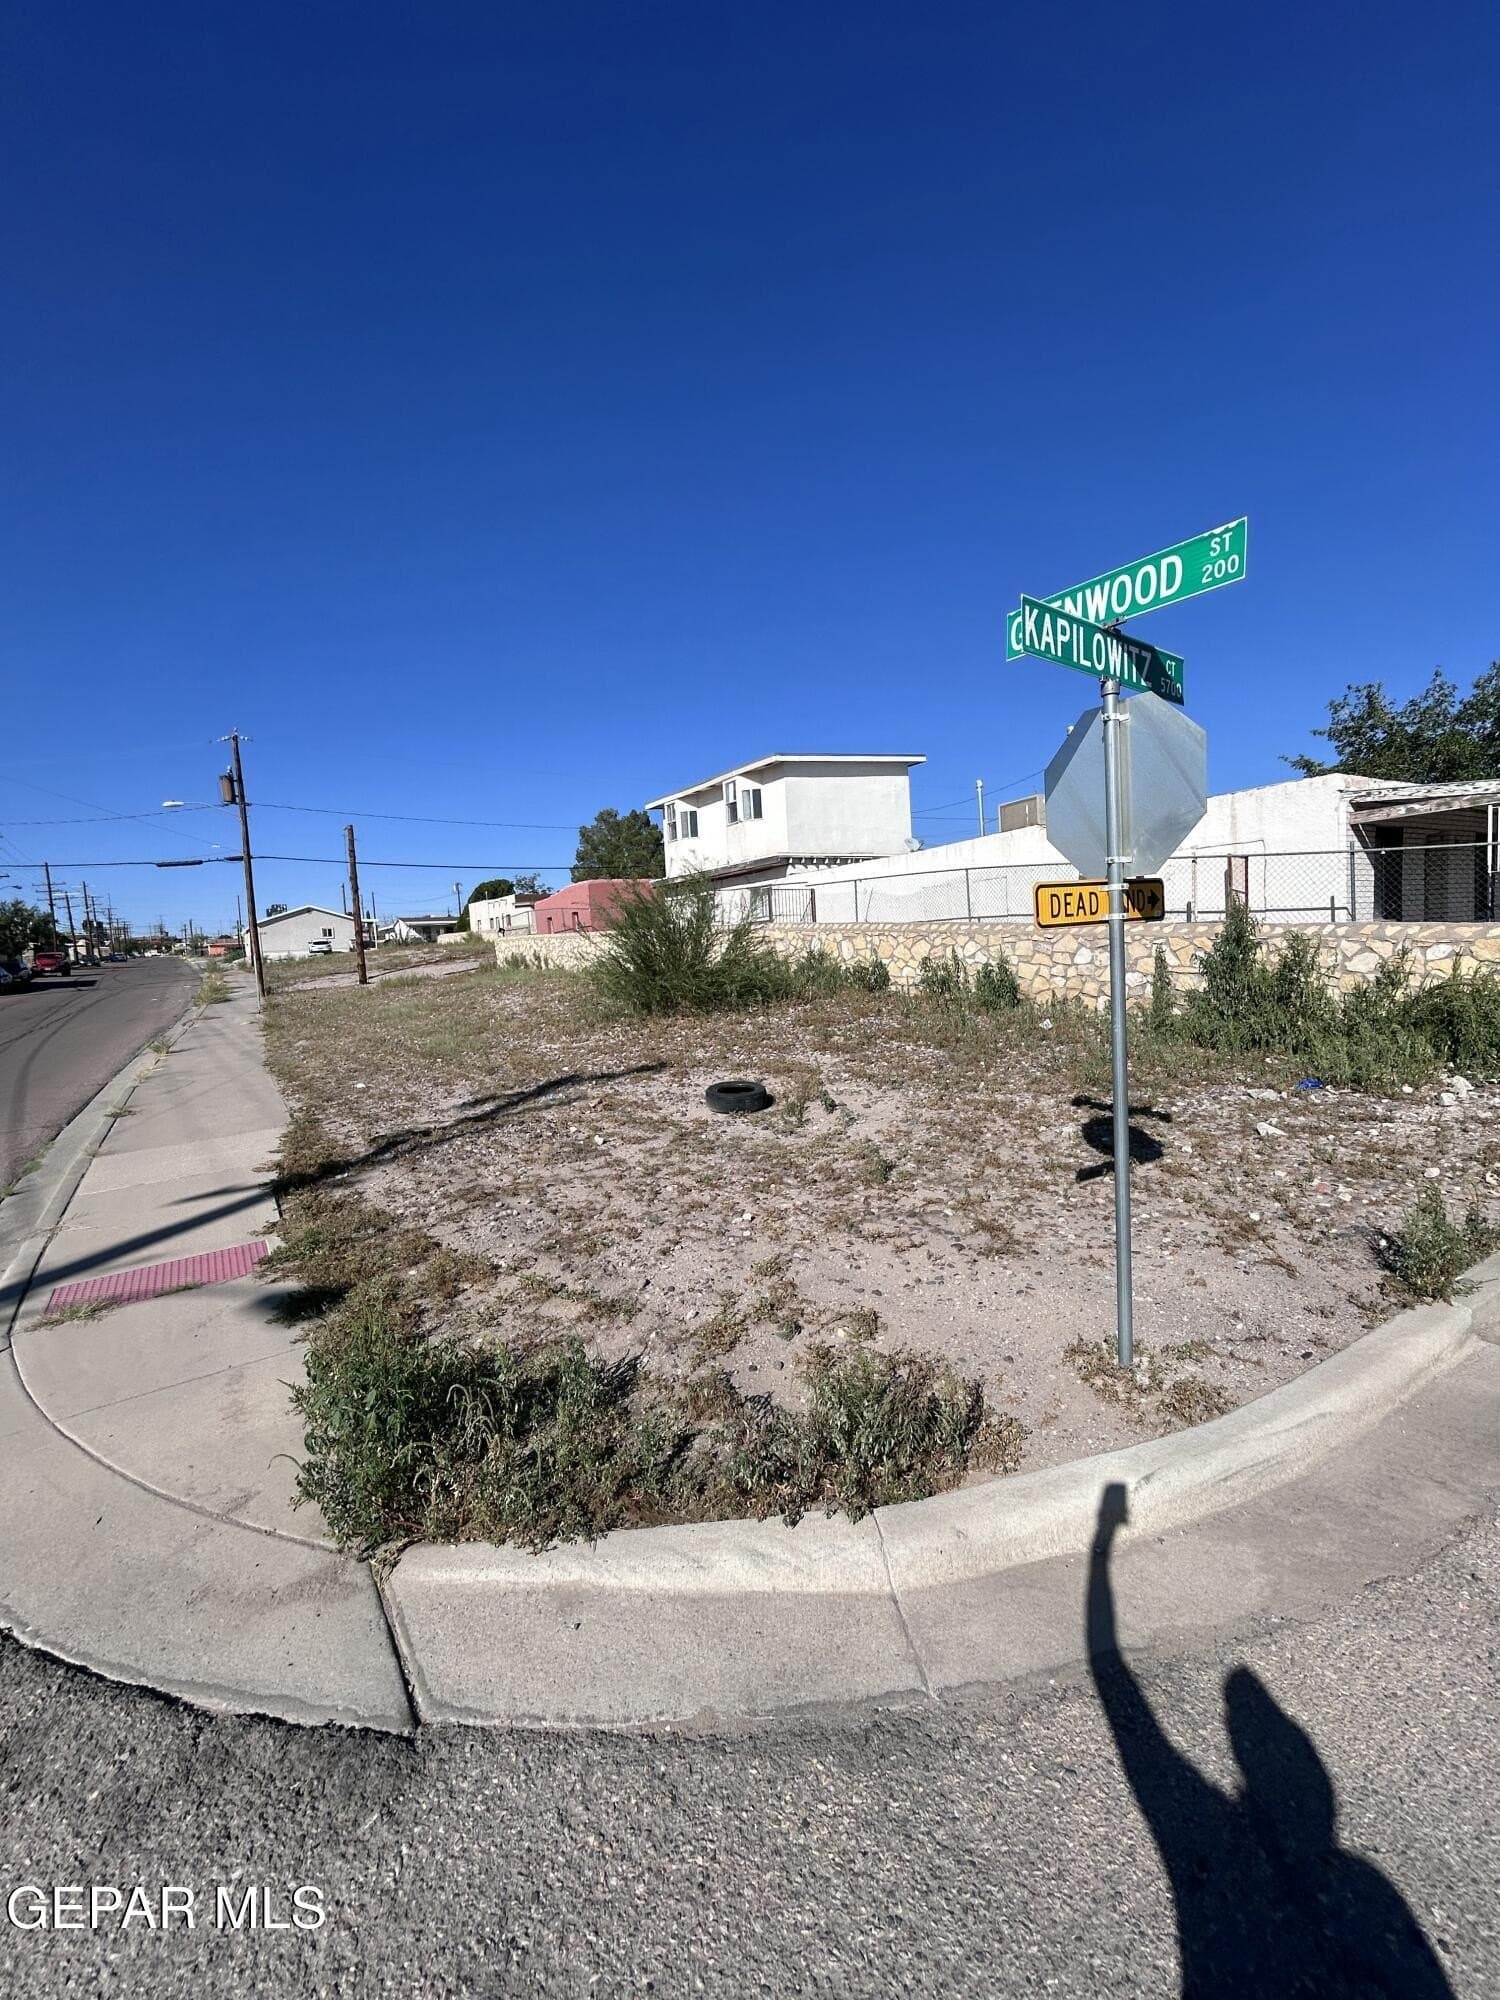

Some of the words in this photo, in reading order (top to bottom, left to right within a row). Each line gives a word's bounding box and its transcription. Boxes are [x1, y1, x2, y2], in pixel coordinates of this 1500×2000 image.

[1202, 554, 1240, 584] 200
[1011, 554, 1183, 650] GNWOOD
[1209, 531, 1233, 557] ST
[1024, 604, 1152, 688] KAPILOWITZ
[1165, 659, 1176, 677] CT
[1160, 677, 1182, 698] 5700
[1050, 891, 1099, 918] DEAD
[1123, 888, 1146, 913] ND
